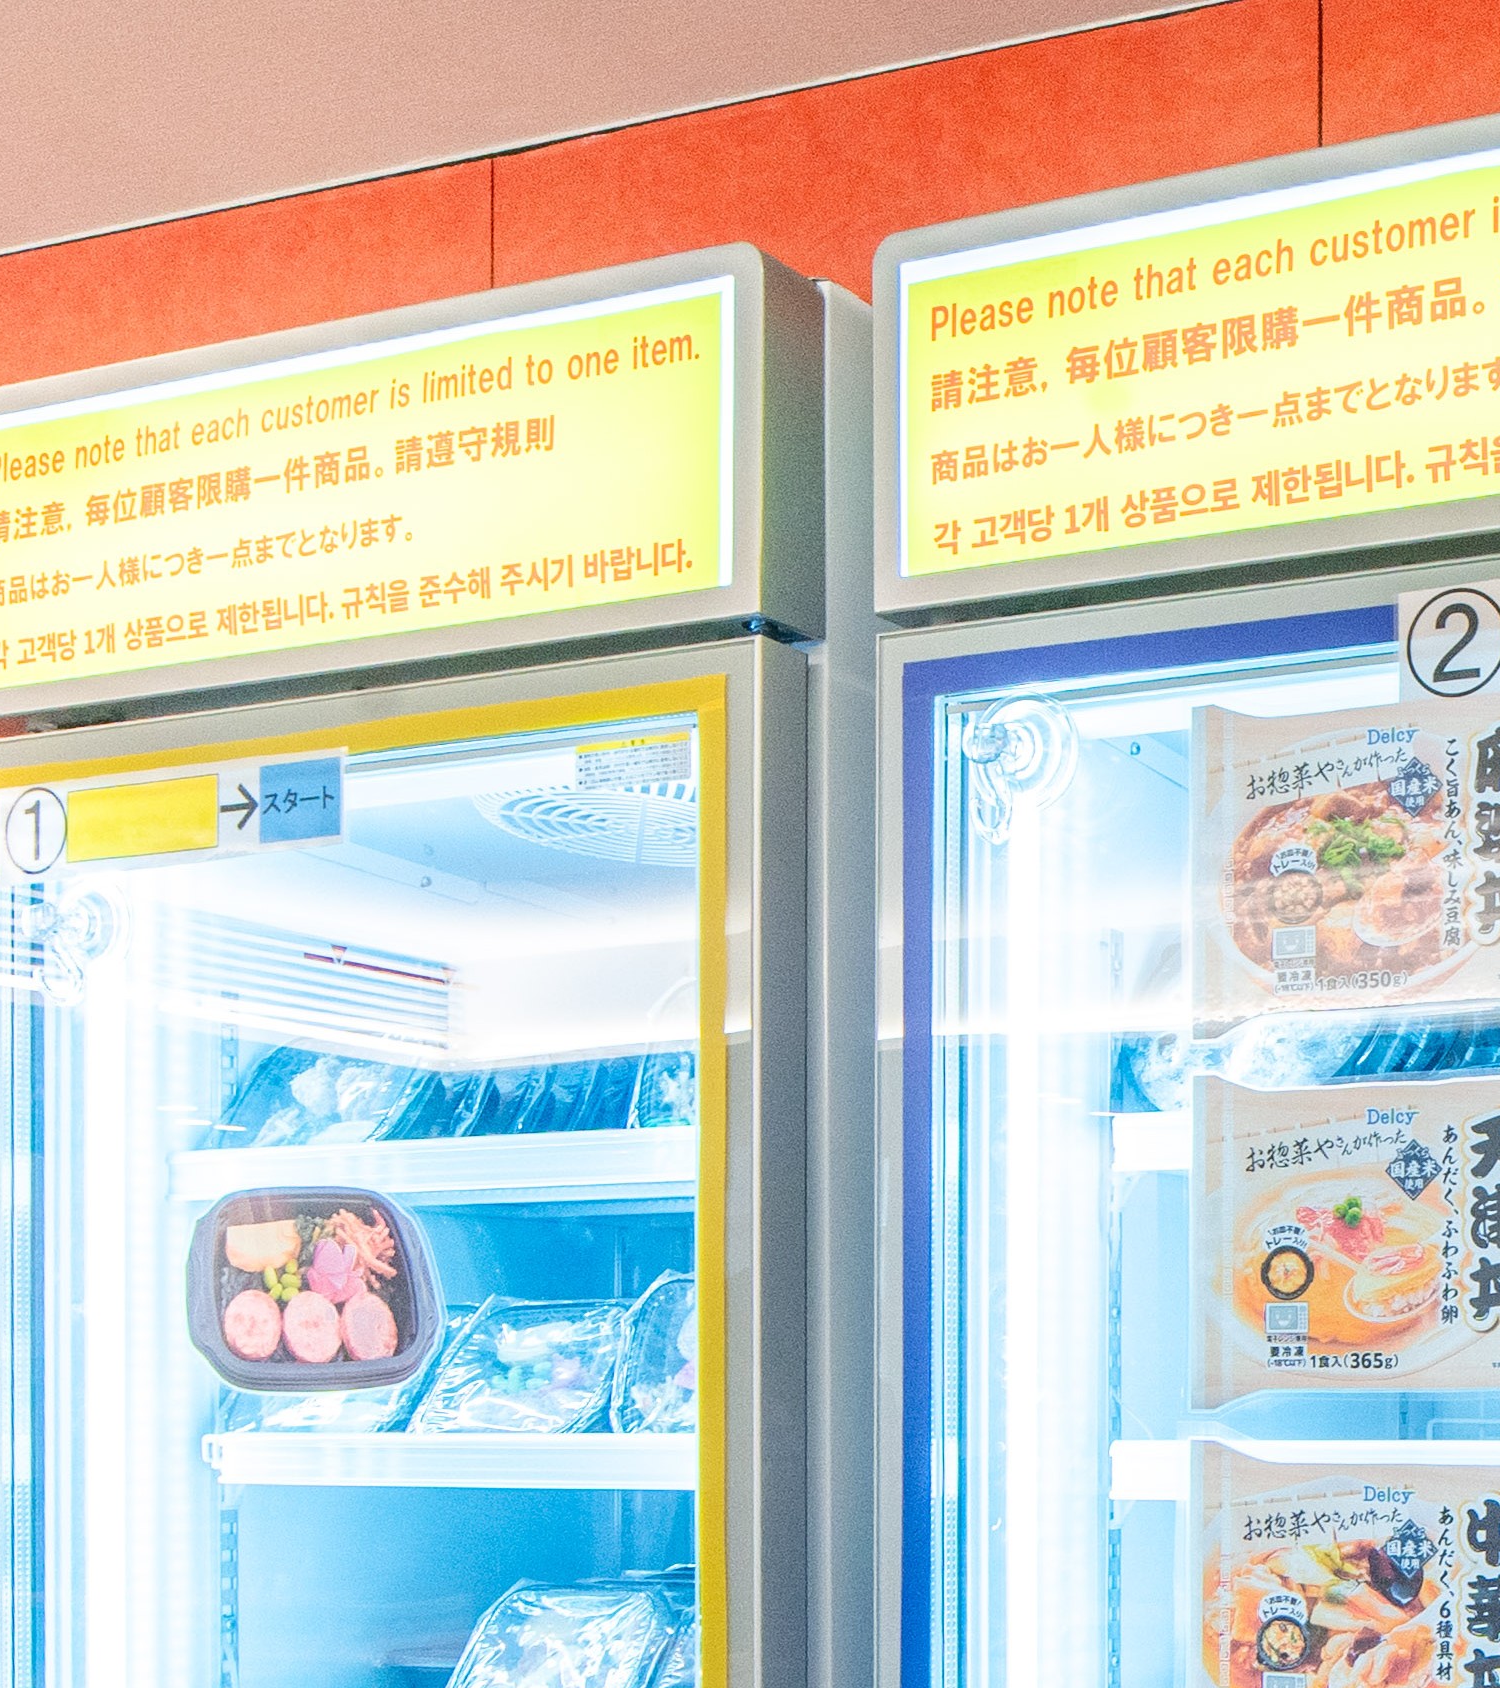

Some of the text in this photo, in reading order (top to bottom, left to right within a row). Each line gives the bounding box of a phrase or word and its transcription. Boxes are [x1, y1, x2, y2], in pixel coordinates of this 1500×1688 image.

[932, 298, 1035, 343] Please
[1049, 277, 1120, 320] note
[1134, 258, 1198, 302] that
[1213, 239, 1295, 287] each
[1311, 210, 1477, 268] customer
[76, 436, 126, 470] note
[137, 423, 181, 458] that
[192, 409, 250, 447] each
[262, 391, 380, 434] customer
[391, 380, 411, 410] is
[424, 357, 513, 404] limited
[526, 355, 554, 387] to
[568, 349, 620, 381] one
[634, 335, 701, 371] item.
[935, 521, 963, 556] 각
[972, 505, 1056, 549] 고객당
[1065, 497, 1110, 536] 1개
[1122, 479, 1241, 529] 상품으로
[1252, 451, 1416, 508] 제한됩니다.
[18, 631, 78, 666] 고객당
[85, 624, 117, 656] 1개
[125, 612, 210, 652] 상품으로
[218, 592, 335, 637] 제한됩니다.
[342, 580, 411, 620] 규칙을
[420, 567, 492, 609] 준수해
[501, 555, 575, 597] 주시기
[584, 539, 694, 585] 바랍니다.
[1367, 727, 1419, 745] Delcy
[1246, 746, 1408, 800] お惣菜やさんが作った
[1390, 775, 1439, 797] 国産米
[262, 784, 335, 816] スタート
[1367, 1108, 1419, 1126] Delcy
[1245, 1129, 1407, 1172] お惣菜やさんが作った
[1390, 1160, 1438, 1179] 国産米
[1440, 1125, 1460, 1324] あんだく、ふわふわ卵
[1364, 1486, 1415, 1504] Delcy
[1243, 1510, 1404, 1541] お惣菜やさんが作った
[1386, 1540, 1436, 1559] 国産米
